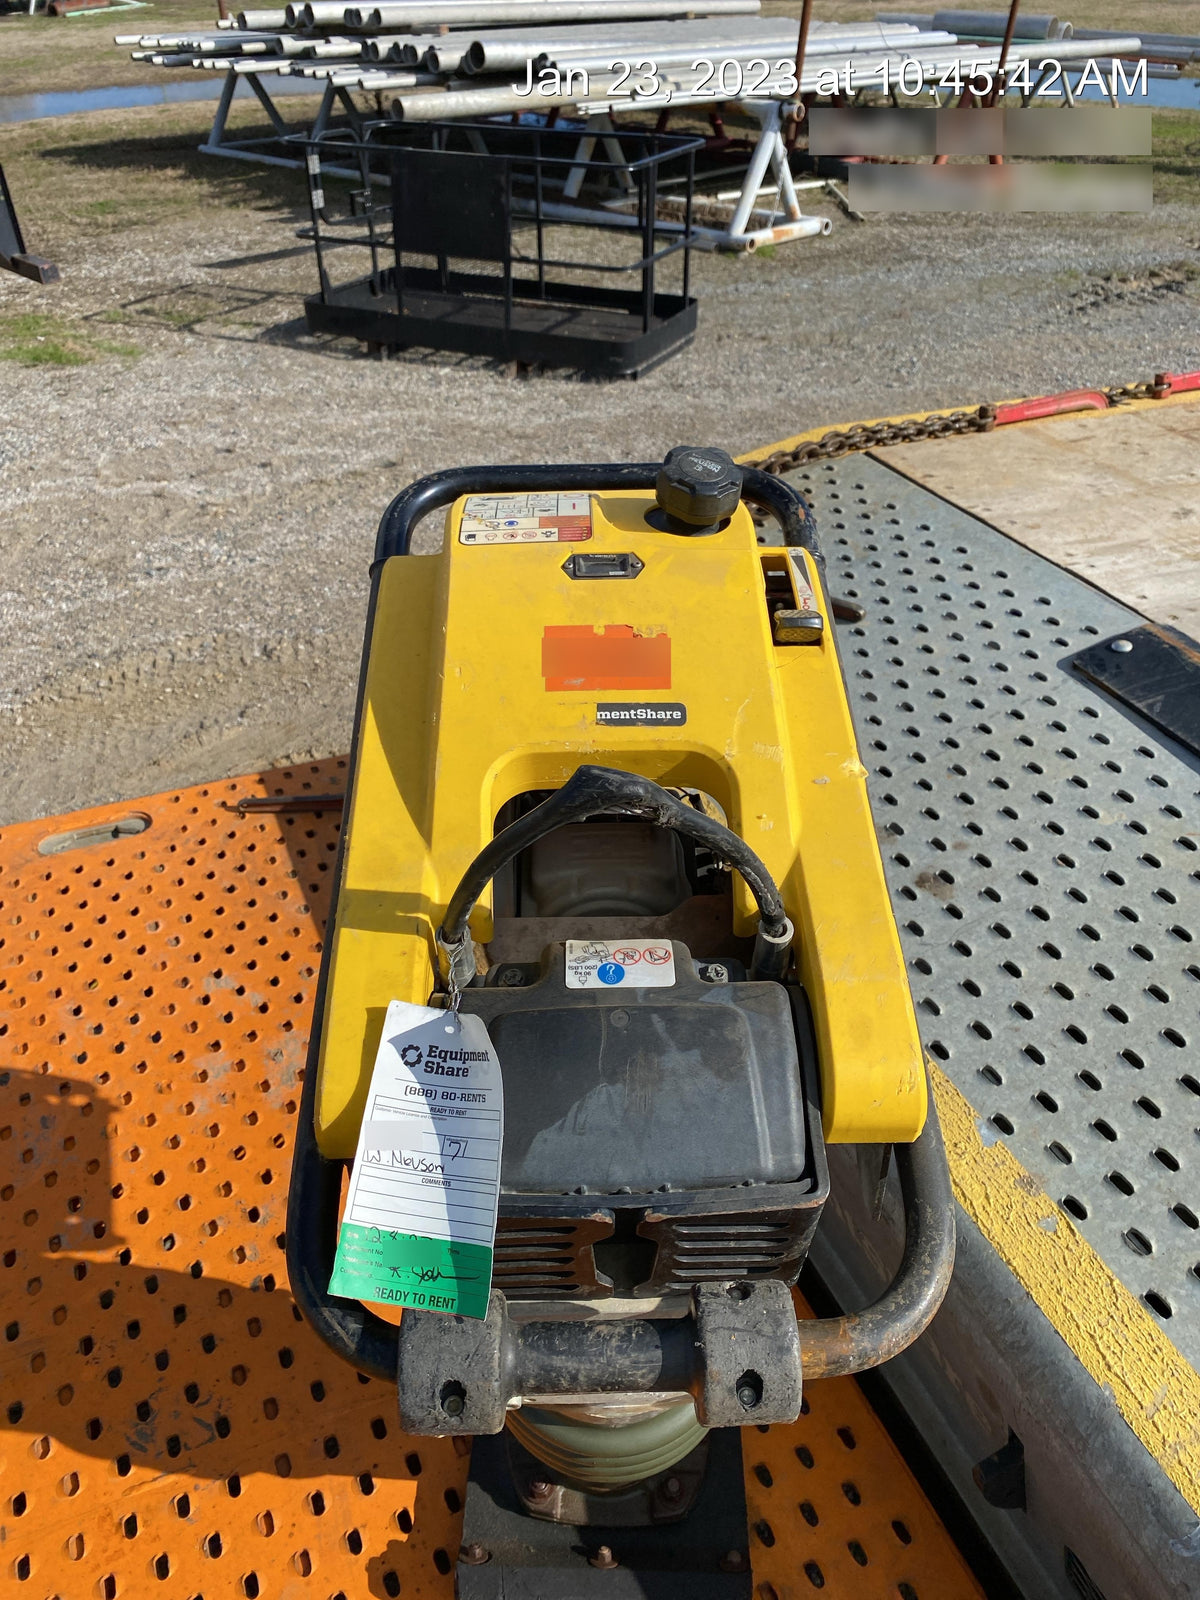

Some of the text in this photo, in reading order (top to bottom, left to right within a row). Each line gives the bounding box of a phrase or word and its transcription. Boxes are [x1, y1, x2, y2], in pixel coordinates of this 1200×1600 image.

[426, 1044, 490, 1064] Equipment
[423, 1060, 471, 1078] Share
[404, 1085, 487, 1103] (888) 80-RENTS
[430, 1106, 447, 1114] READY
[447, 1107, 455, 1115] TO
[421, 1177, 452, 1187] COMMENTS
[372, 1286, 457, 1310] READY TO RENT
